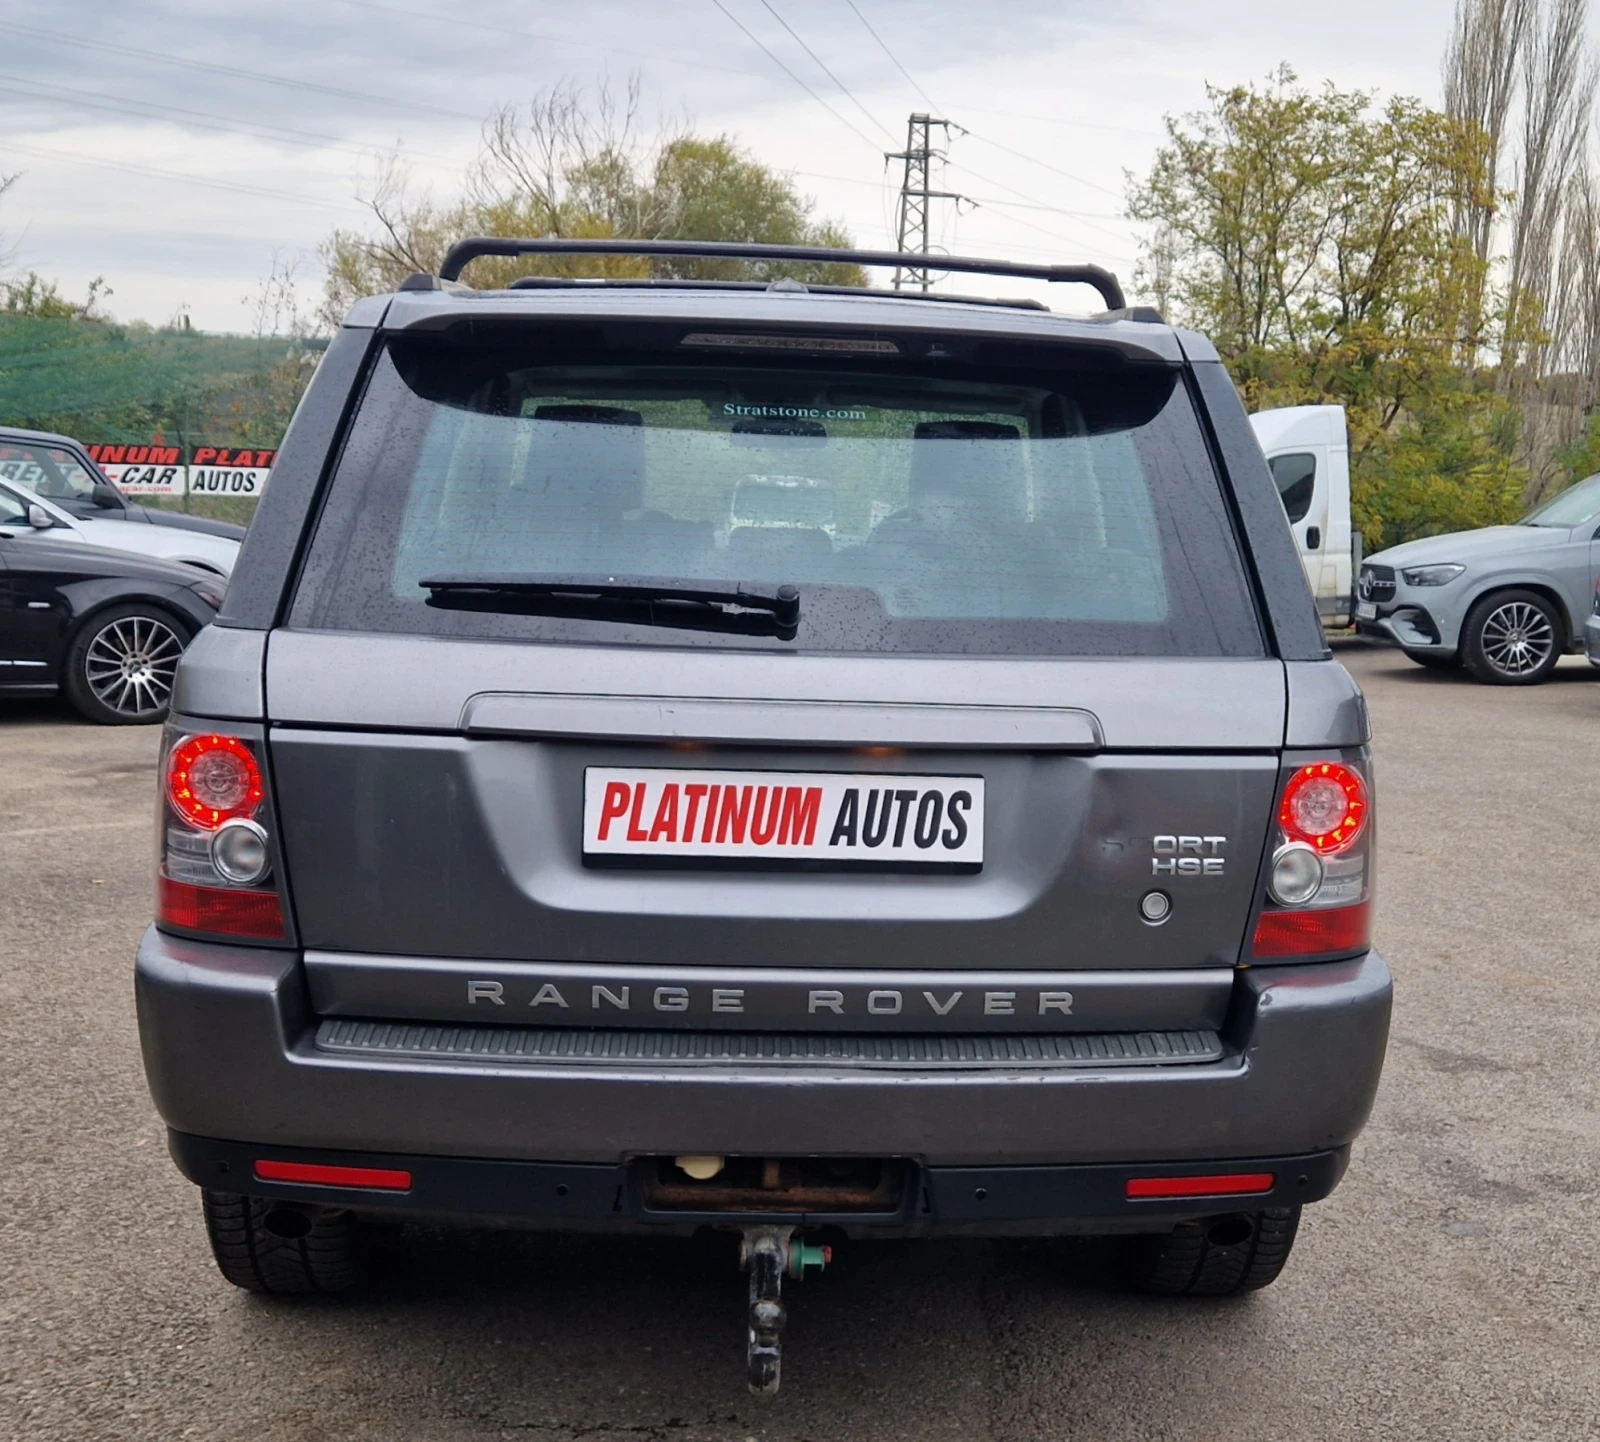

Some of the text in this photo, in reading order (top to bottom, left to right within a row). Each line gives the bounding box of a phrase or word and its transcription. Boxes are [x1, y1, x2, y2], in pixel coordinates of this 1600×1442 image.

[723, 403, 867, 420] Stratstone.com
[191, 469, 257, 493] AUTOS
[597, 781, 973, 851] PLATINUM AUTOS
[1152, 835, 1227, 854] ORT
[1151, 857, 1225, 876] HSE
[467, 980, 1074, 1015] RANGE ROVER
